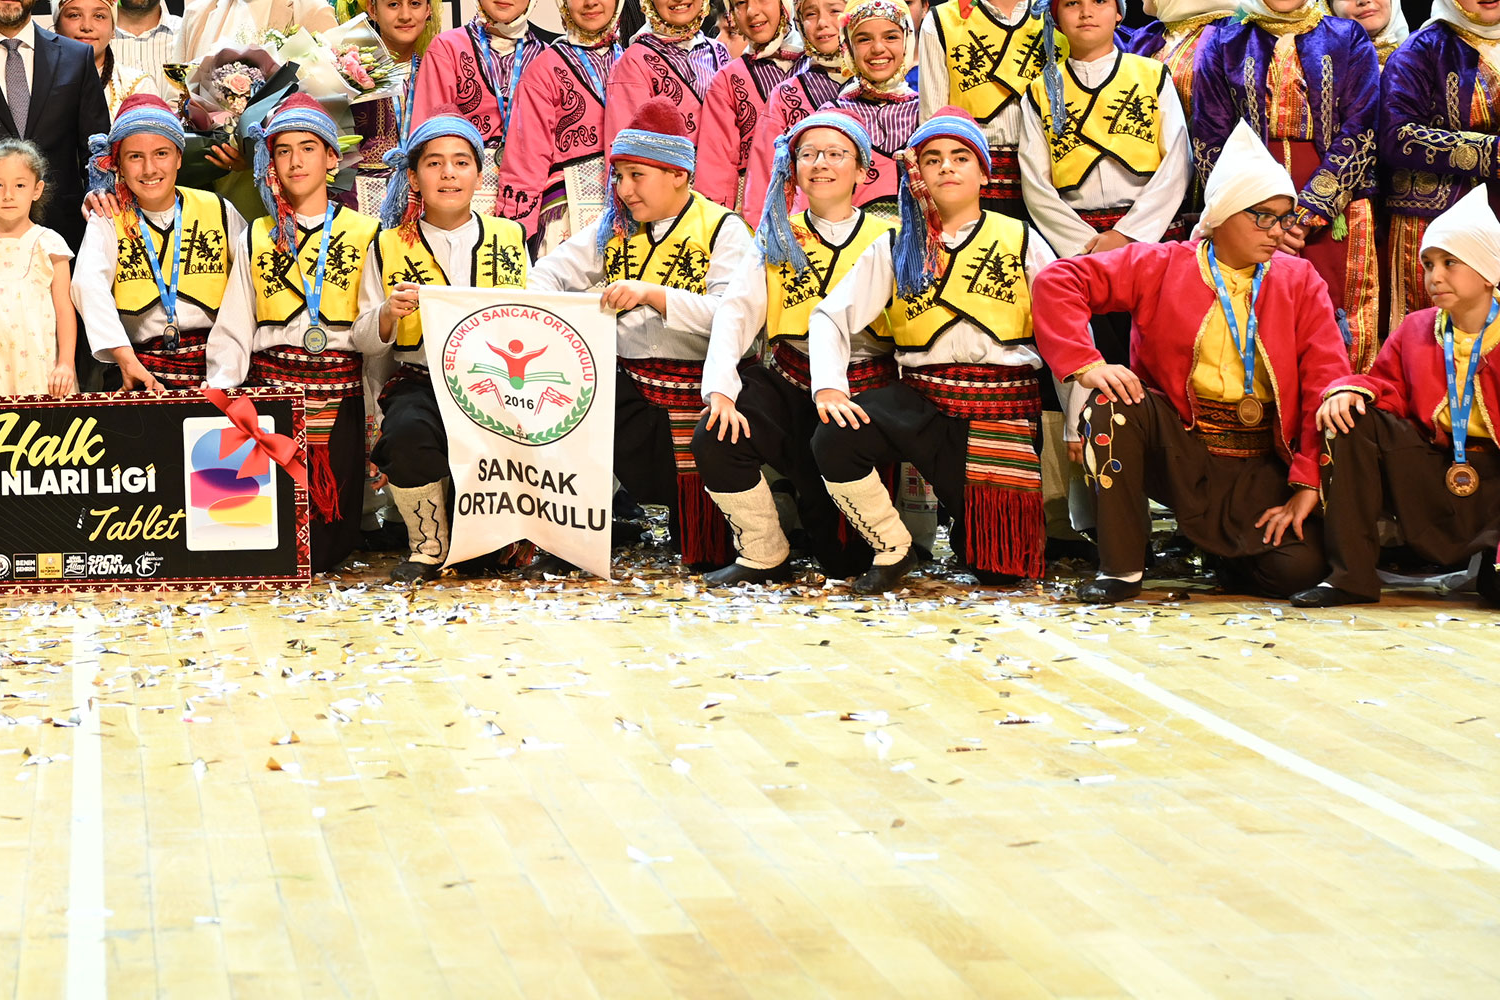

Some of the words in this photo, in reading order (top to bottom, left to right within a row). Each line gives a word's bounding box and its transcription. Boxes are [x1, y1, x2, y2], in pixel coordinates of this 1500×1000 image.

[445, 317, 480, 371] SELÇUKLU
[481, 307, 541, 322] SANCAK
[543, 315, 594, 382] ORTAOKULU
[504, 394, 535, 410] 2016
[96, 463, 156, 494] LİGİ
[477, 458, 578, 496] SANCAK
[88, 504, 186, 542] Tablet
[458, 491, 606, 531] ORTAOKULU
[87, 554, 124, 565] SPOR
[88, 562, 133, 575] KONYA
